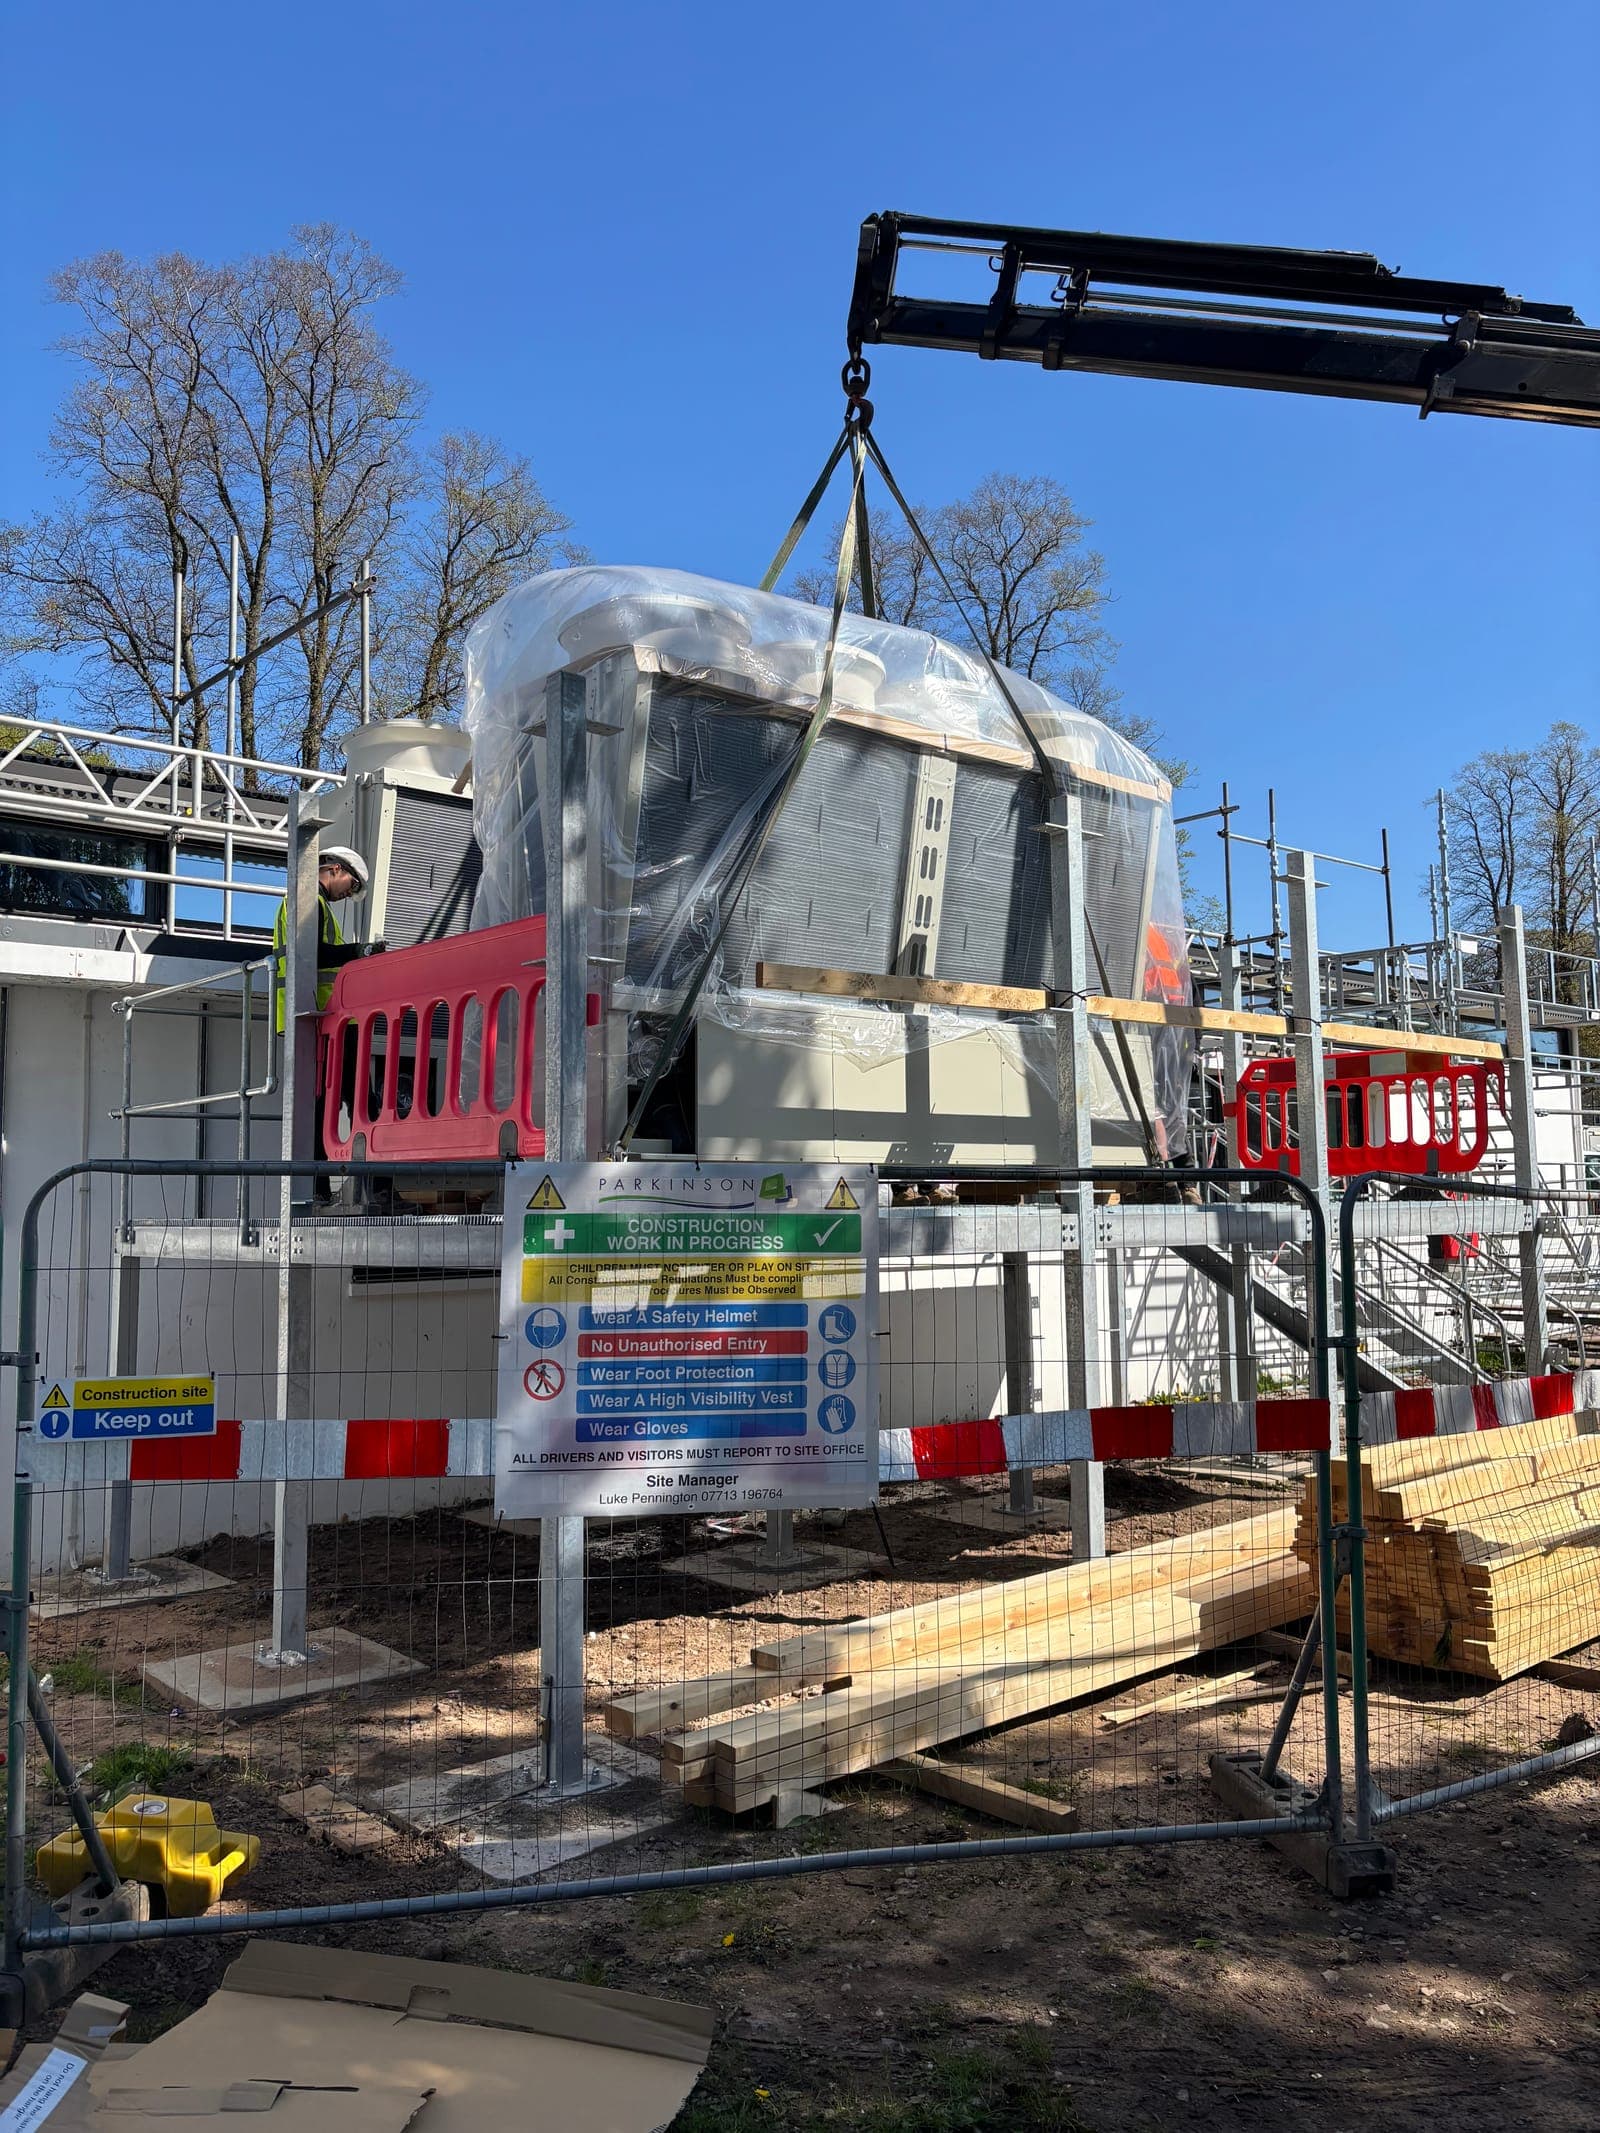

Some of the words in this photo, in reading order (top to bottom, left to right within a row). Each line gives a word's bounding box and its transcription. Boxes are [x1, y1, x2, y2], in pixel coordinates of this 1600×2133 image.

[599, 1178, 754, 1191] PARKINSON
[627, 1219, 764, 1234] CONSTRUCTION
[607, 1236, 660, 1250] WORK
[666, 1236, 682, 1250] IN
[688, 1235, 784, 1250] PROGRESS
[569, 1263, 627, 1273] CHILDREN
[689, 1263, 725, 1272] TER
[728, 1262, 745, 1272] OR
[747, 1262, 774, 1272] PLAY
[777, 1262, 792, 1272] ON
[795, 1261, 817, 1271] SIT
[549, 1276, 562, 1285] All
[662, 1274, 722, 1285] Regulations
[725, 1274, 750, 1283] Must
[752, 1273, 765, 1283] be
[768, 1273, 813, 1285] compli
[704, 1285, 729, 1295] Must
[732, 1285, 745, 1295] be
[747, 1285, 796, 1295] Observed
[592, 1311, 631, 1325] Wear
[636, 1311, 648, 1324] A
[651, 1310, 700, 1326] Safety
[705, 1309, 758, 1323] Helmet
[591, 1339, 613, 1352] No
[618, 1337, 722, 1352] Unauthorised
[727, 1337, 768, 1353] Entry
[591, 1367, 631, 1381] Wear
[635, 1367, 670, 1380] Foot
[675, 1365, 755, 1380] Protection
[81, 1387, 177, 1401] Construction
[181, 1385, 208, 1398] site
[589, 1394, 630, 1408] Wear
[634, 1394, 646, 1407] A
[650, 1392, 685, 1409] High
[690, 1391, 756, 1408] Visibility
[761, 1390, 793, 1404] Vest
[94, 1411, 151, 1432] Keep
[158, 1409, 194, 1427] out
[589, 1423, 630, 1437] Wear
[634, 1421, 689, 1436] Gloves
[512, 1453, 537, 1464] ALL
[540, 1452, 595, 1463] DRIVERS
[598, 1451, 624, 1462] AND
[627, 1450, 683, 1461] VISITORS
[686, 1448, 720, 1459] MUST
[723, 1447, 772, 1458] REPORT
[775, 1446, 791, 1456] TO
[794, 1445, 820, 1456] SITE
[823, 1444, 865, 1455] OFFICE
[646, 1475, 673, 1487] Site
[678, 1474, 739, 1488] Manager
[599, 1493, 628, 1505] Luke
[631, 1492, 698, 1505] Pennington
[701, 1490, 737, 1501] 07713
[742, 1488, 783, 1500] 196764
